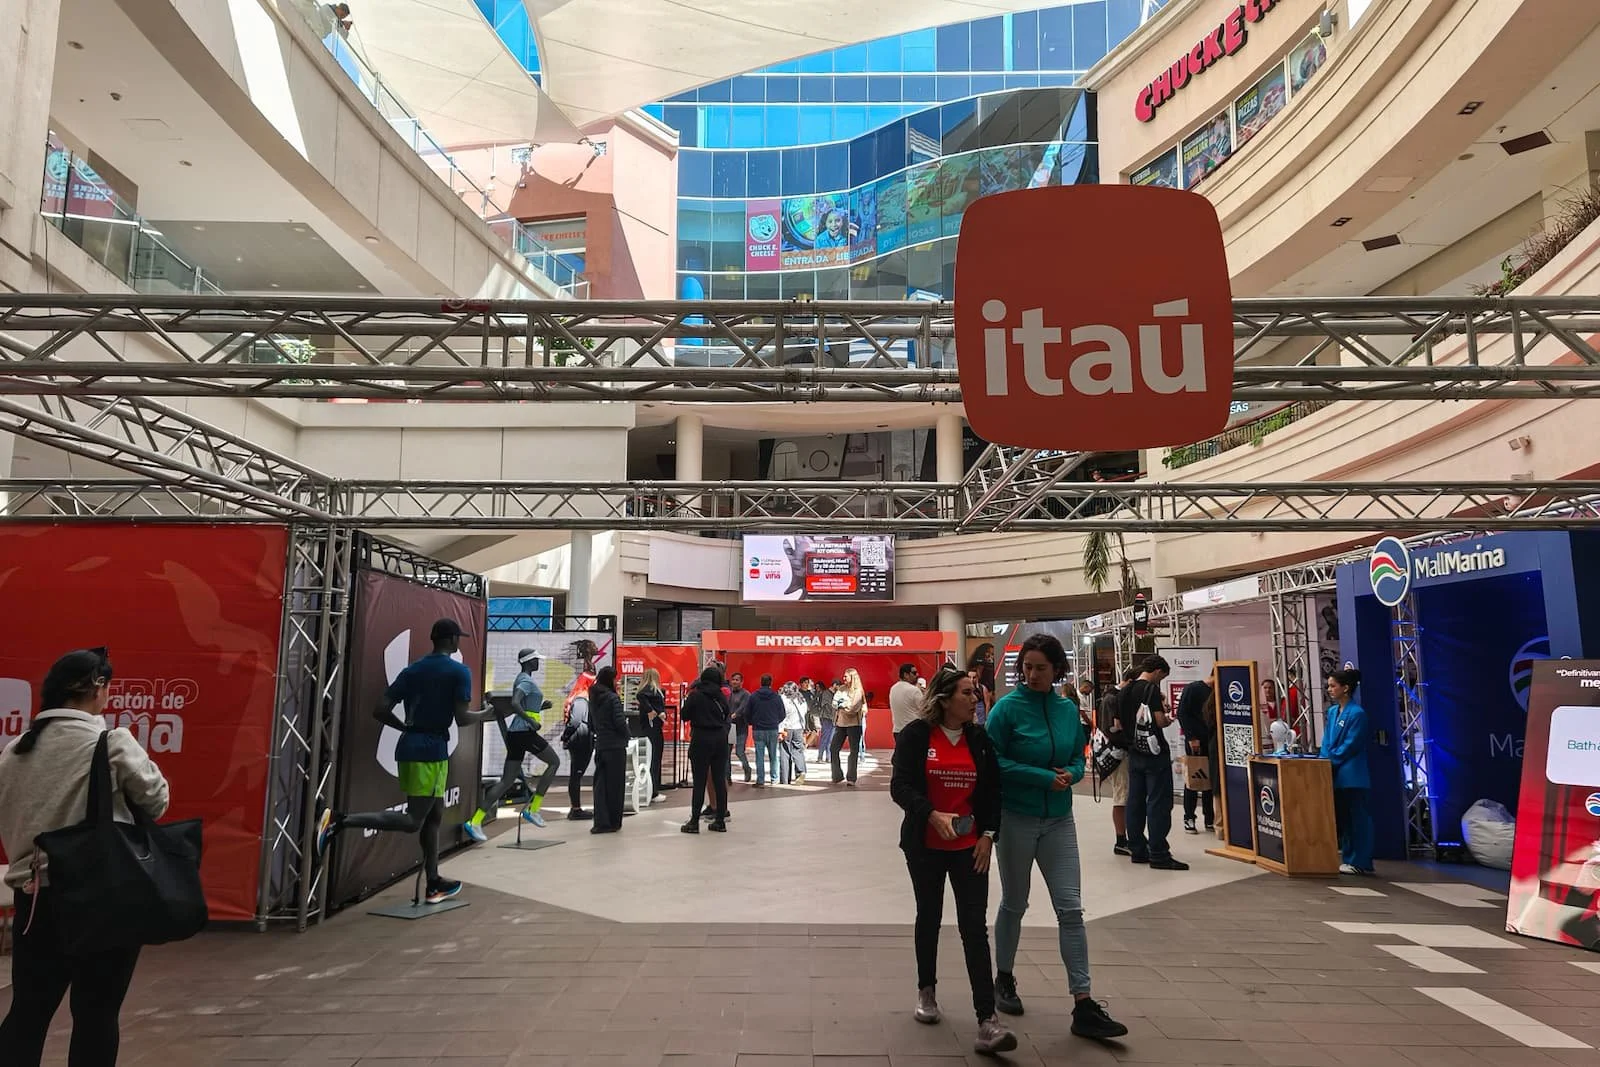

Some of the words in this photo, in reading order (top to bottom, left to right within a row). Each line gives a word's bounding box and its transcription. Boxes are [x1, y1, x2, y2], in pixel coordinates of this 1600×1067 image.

[1237, 97, 1258, 121] PIZZAS
[784, 256, 829, 266] ENTRADA
[835, 246, 875, 262] LIBERADA
[982, 298, 1207, 396] itaú
[1415, 544, 1505, 579] MallMarina
[756, 635, 822, 646] ENTREGA
[825, 635, 844, 646] DE
[847, 635, 903, 646] POLERA
[162, 692, 185, 709] de
